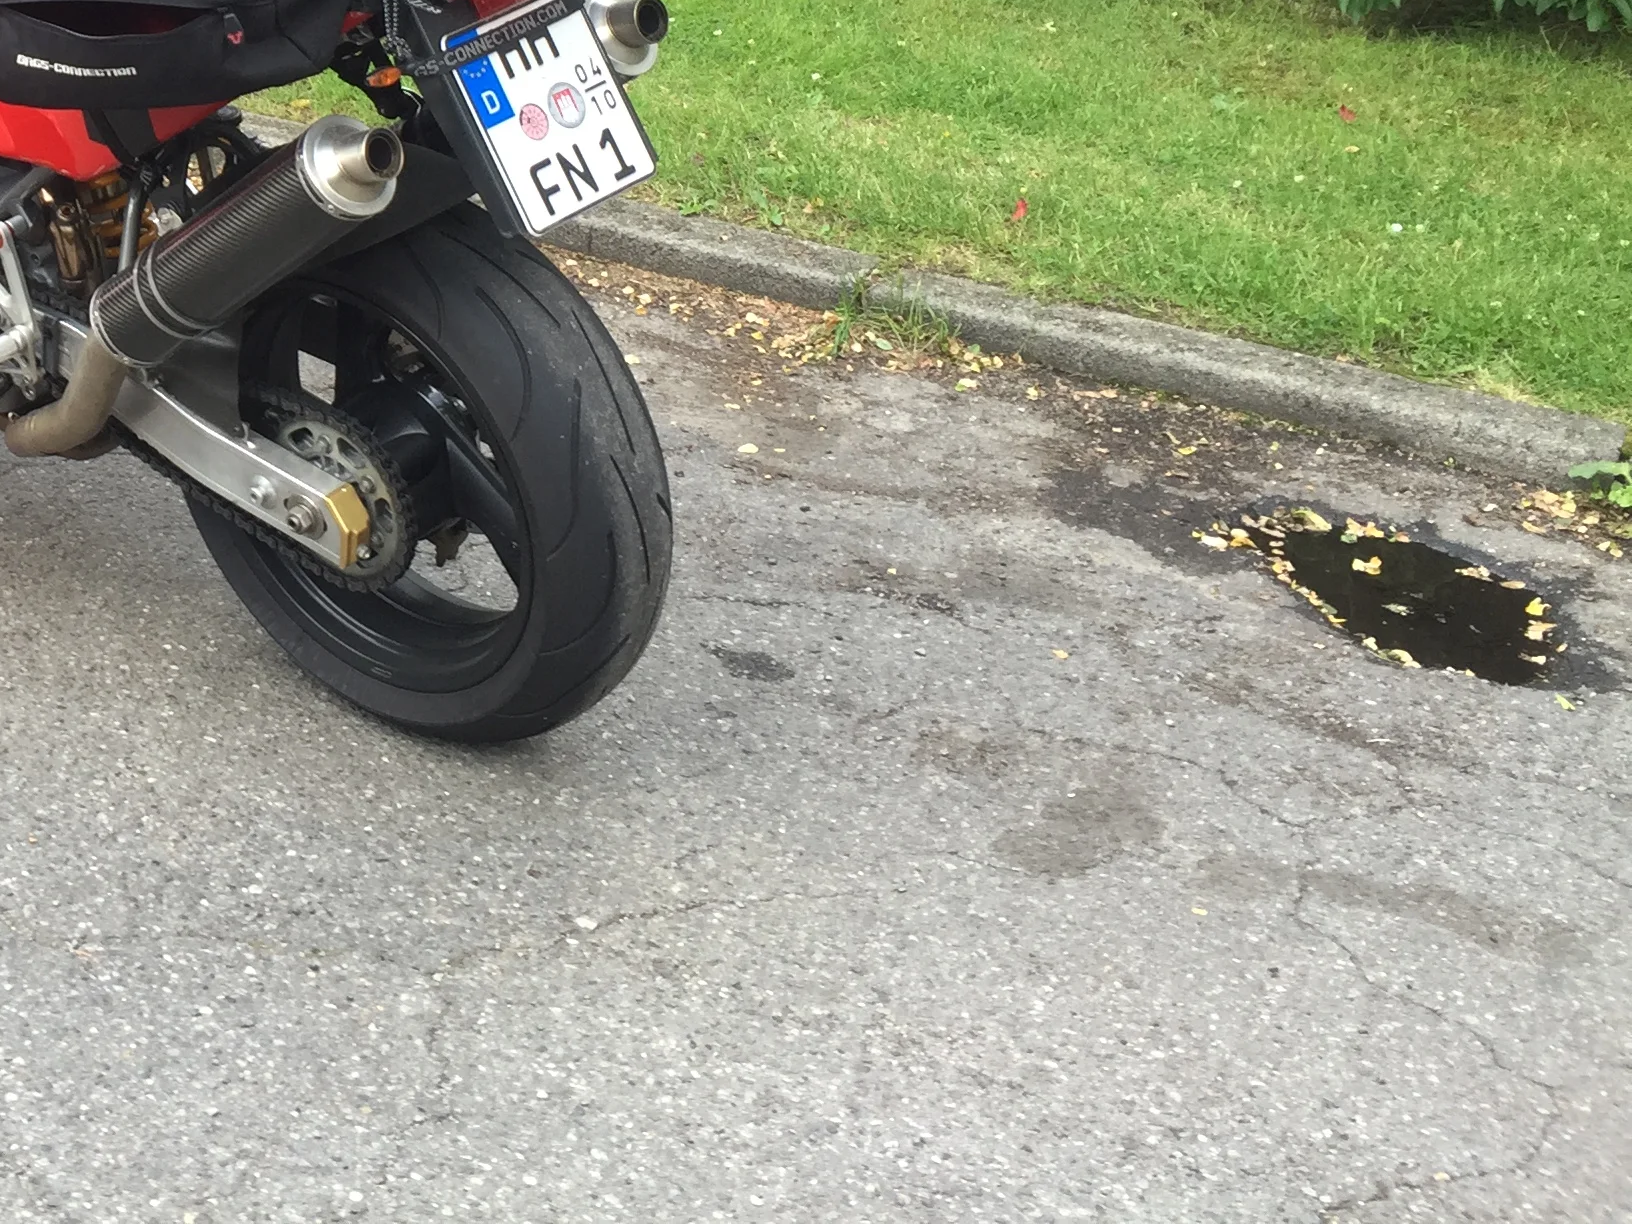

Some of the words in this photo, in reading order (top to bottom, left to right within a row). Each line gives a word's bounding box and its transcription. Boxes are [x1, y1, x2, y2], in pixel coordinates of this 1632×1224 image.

[480, 89, 501, 115] D
[590, 88, 617, 116] 10
[529, 142, 600, 217] FN
[599, 127, 637, 182] 1
